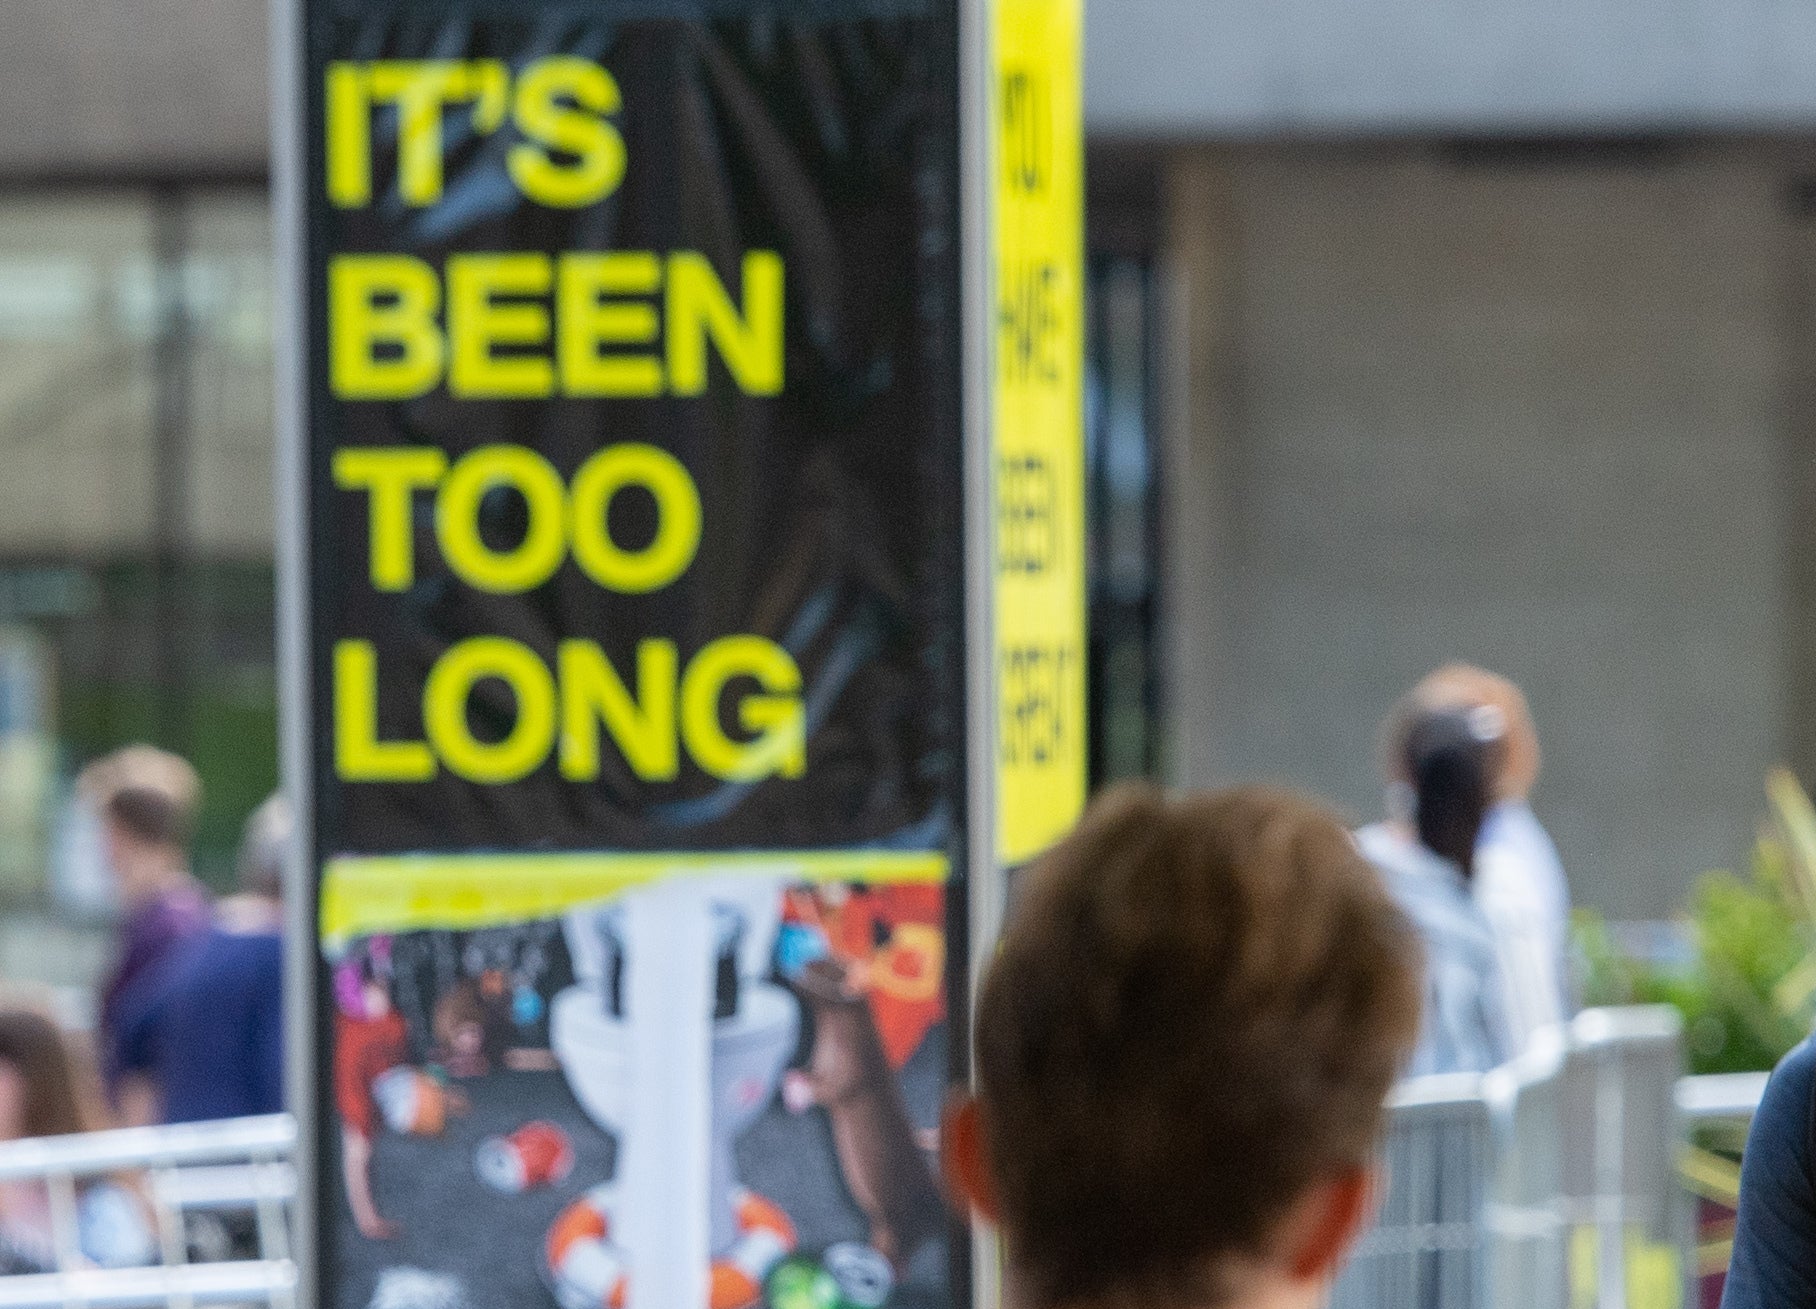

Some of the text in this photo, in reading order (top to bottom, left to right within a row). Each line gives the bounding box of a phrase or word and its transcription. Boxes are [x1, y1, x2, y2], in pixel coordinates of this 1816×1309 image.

[325, 57, 626, 208] IT'S
[328, 251, 785, 399] BEEN
[332, 443, 702, 593] TOO
[332, 633, 807, 784] LONG
